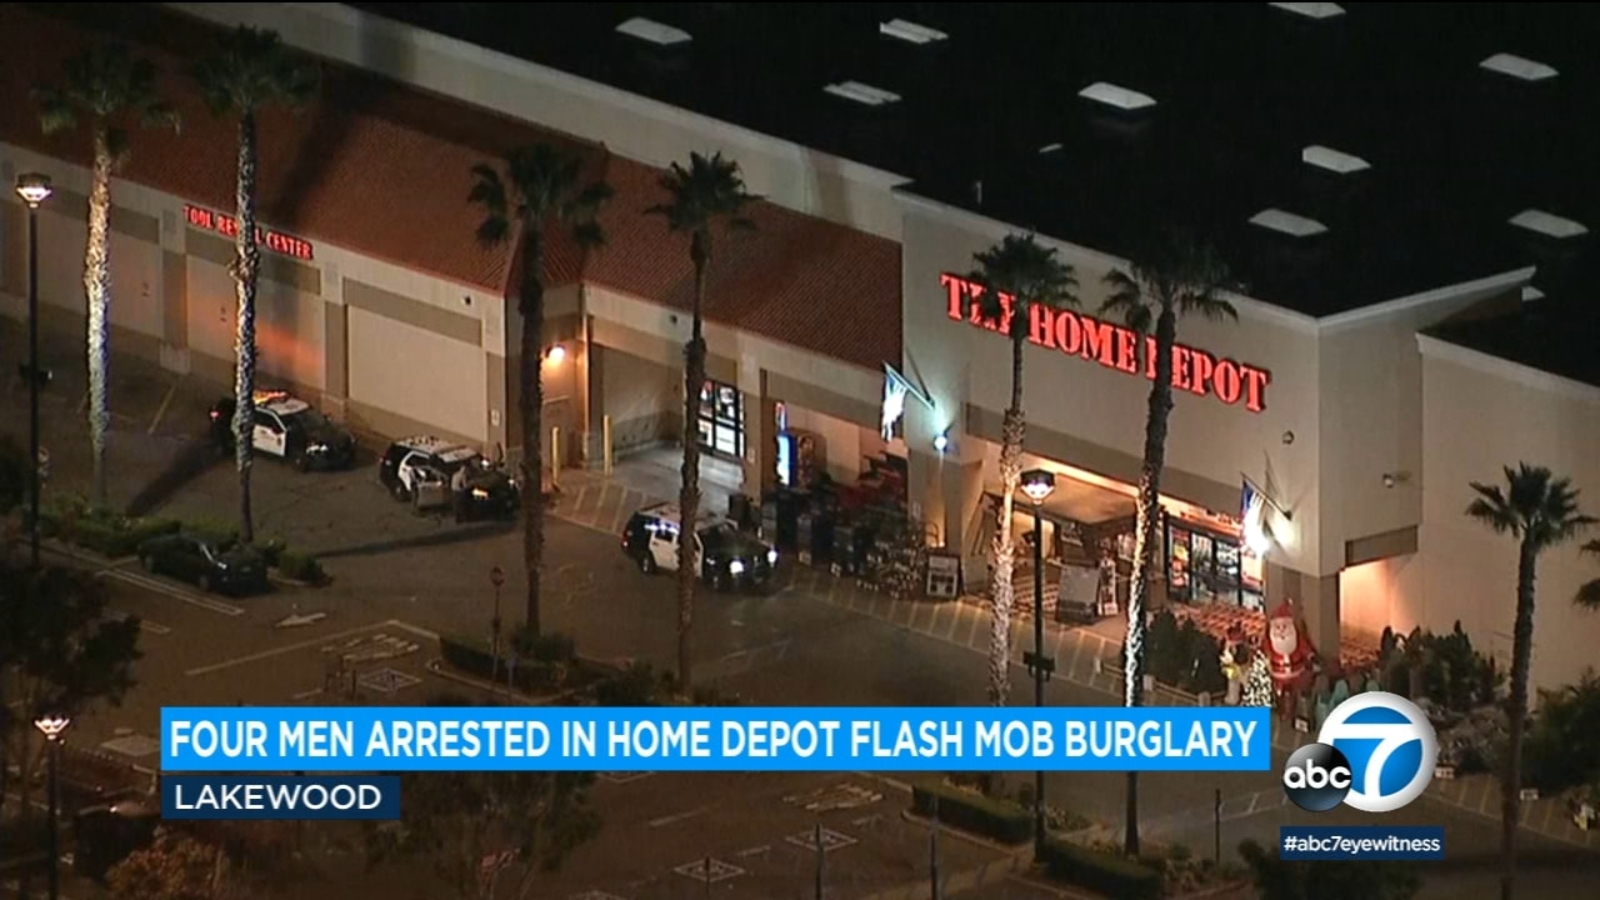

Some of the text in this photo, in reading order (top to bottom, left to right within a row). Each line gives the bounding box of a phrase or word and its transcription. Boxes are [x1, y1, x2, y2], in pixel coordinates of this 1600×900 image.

[183, 205, 213, 229] TOOL
[265, 231, 312, 259] CENTER
[1028, 303, 1136, 373] HOME
